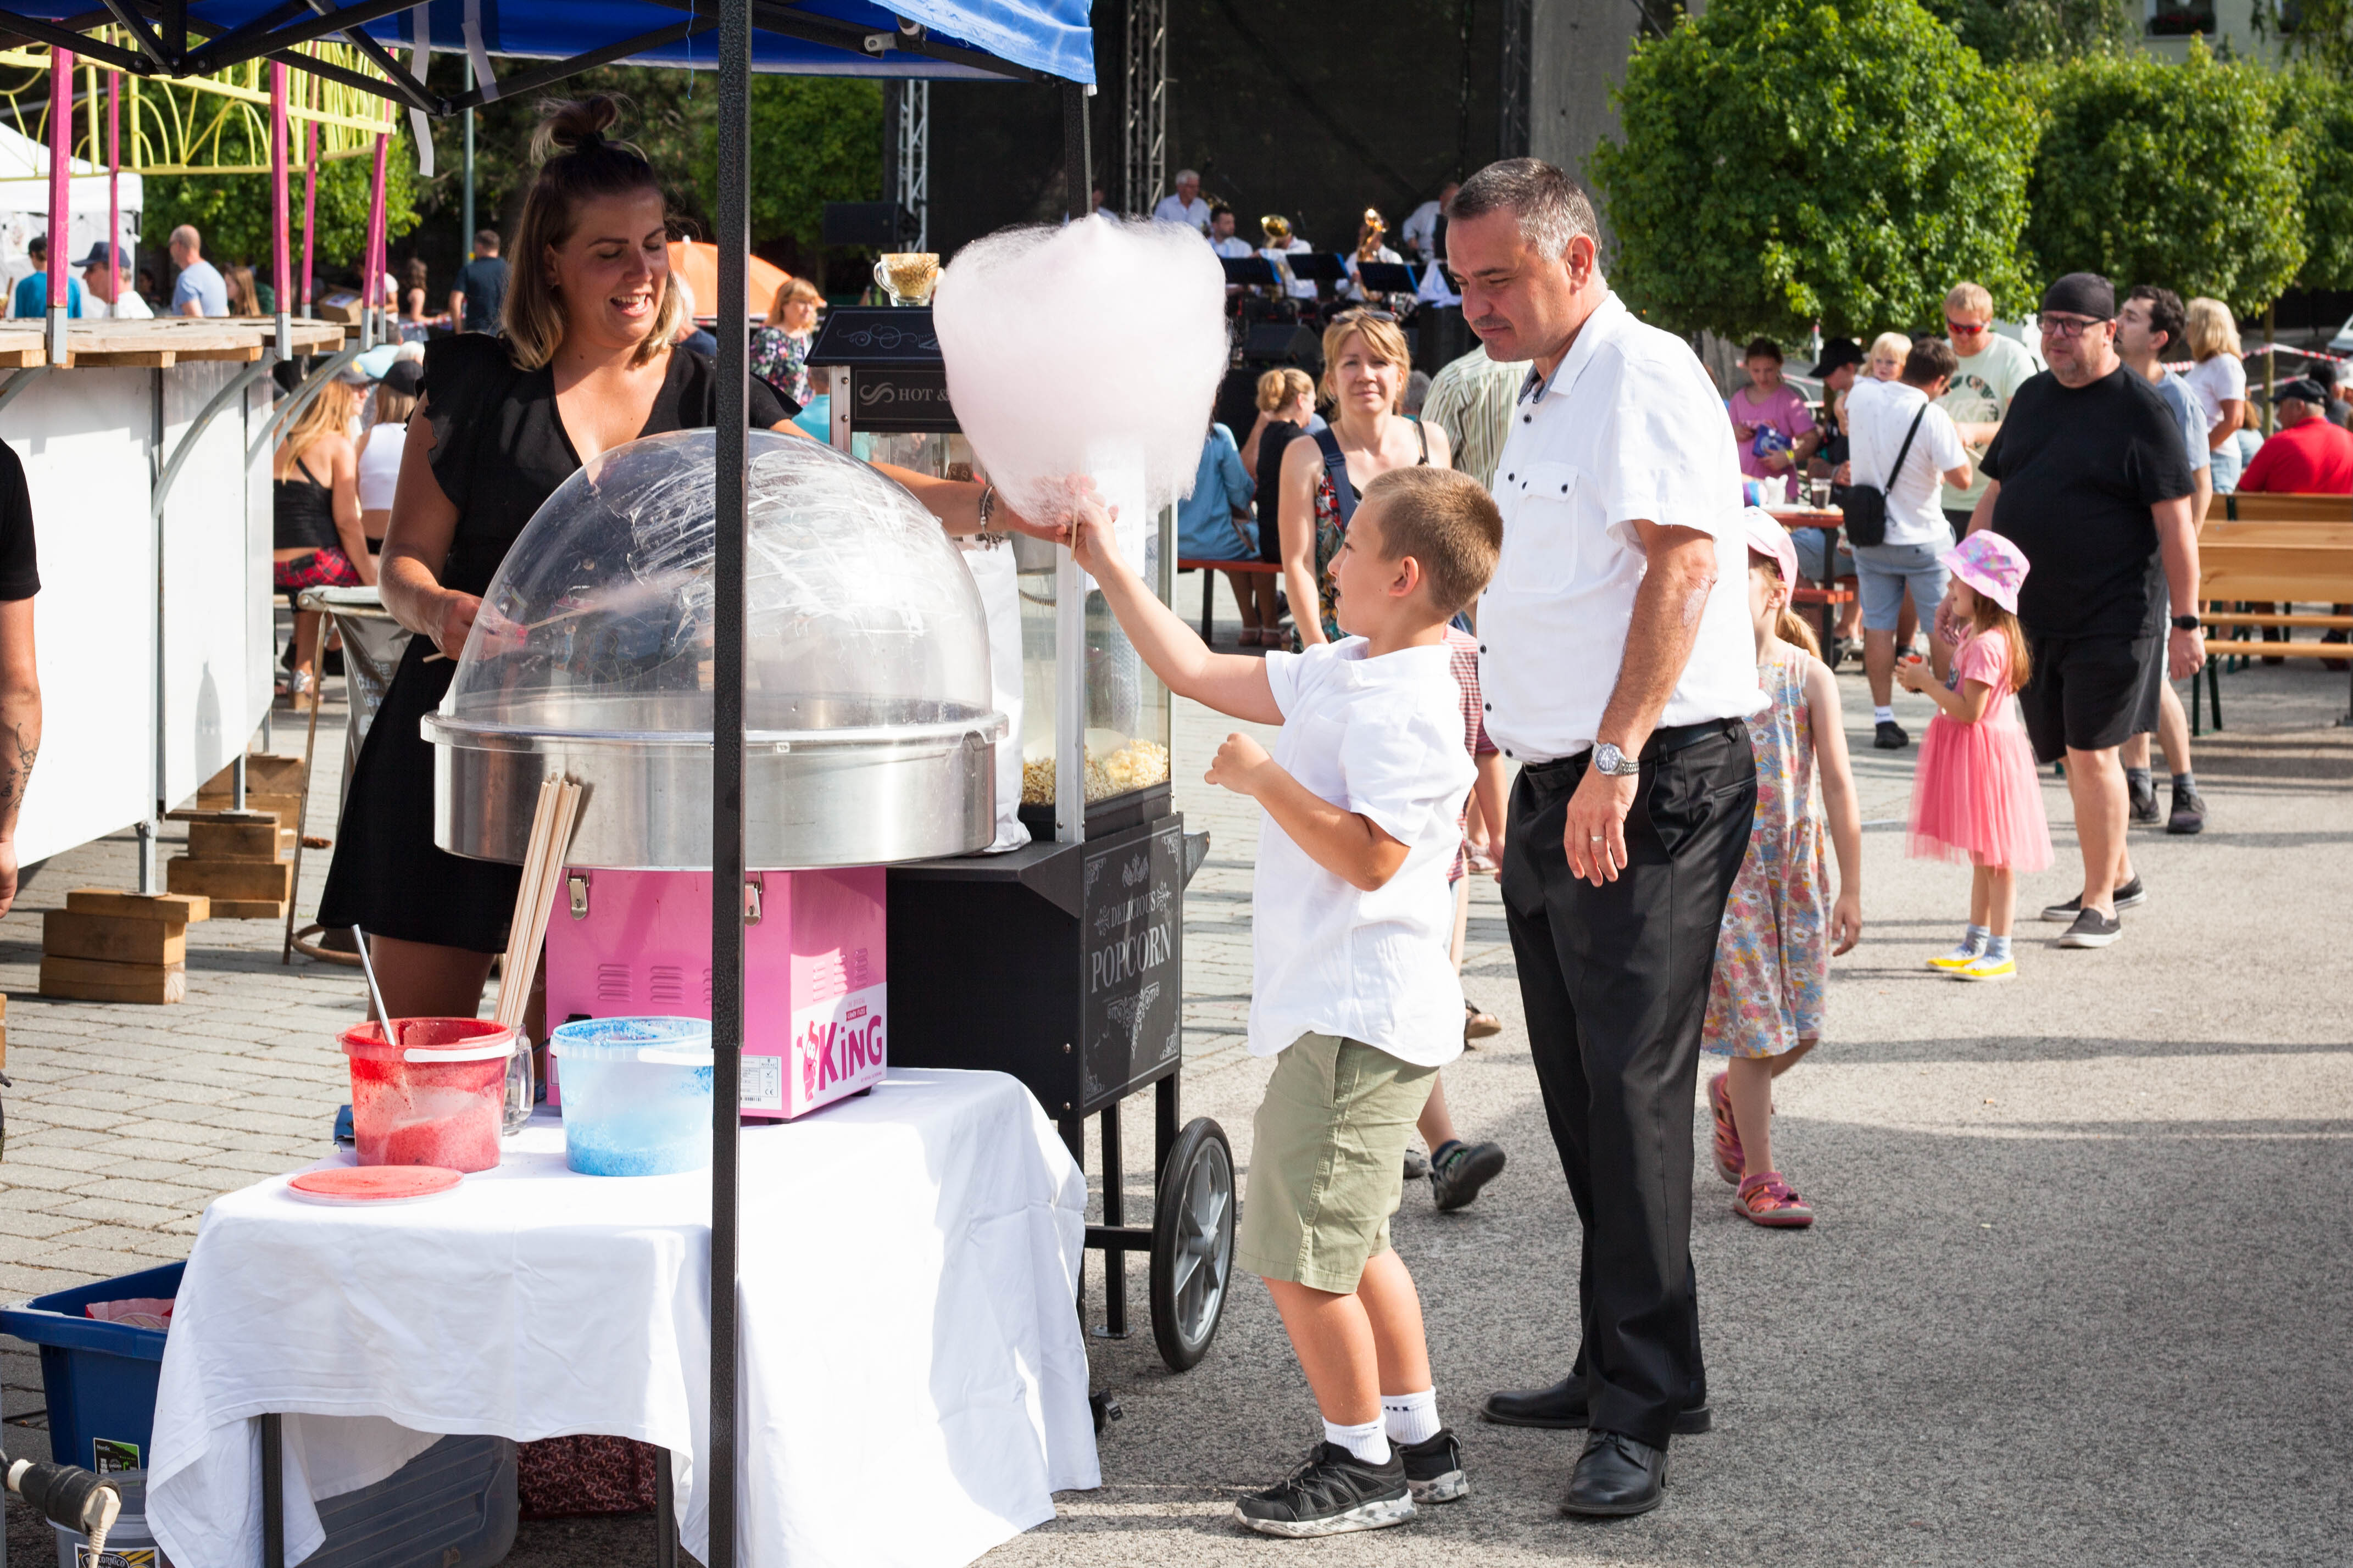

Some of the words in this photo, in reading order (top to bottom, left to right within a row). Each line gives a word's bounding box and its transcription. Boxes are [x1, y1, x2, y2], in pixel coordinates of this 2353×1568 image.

[898, 388, 933, 401] HOT
[1111, 890, 1156, 928] DELICIOUS
[1091, 920, 1171, 994] POPCORN
[85, 1555, 125, 1567] PCORNICO
